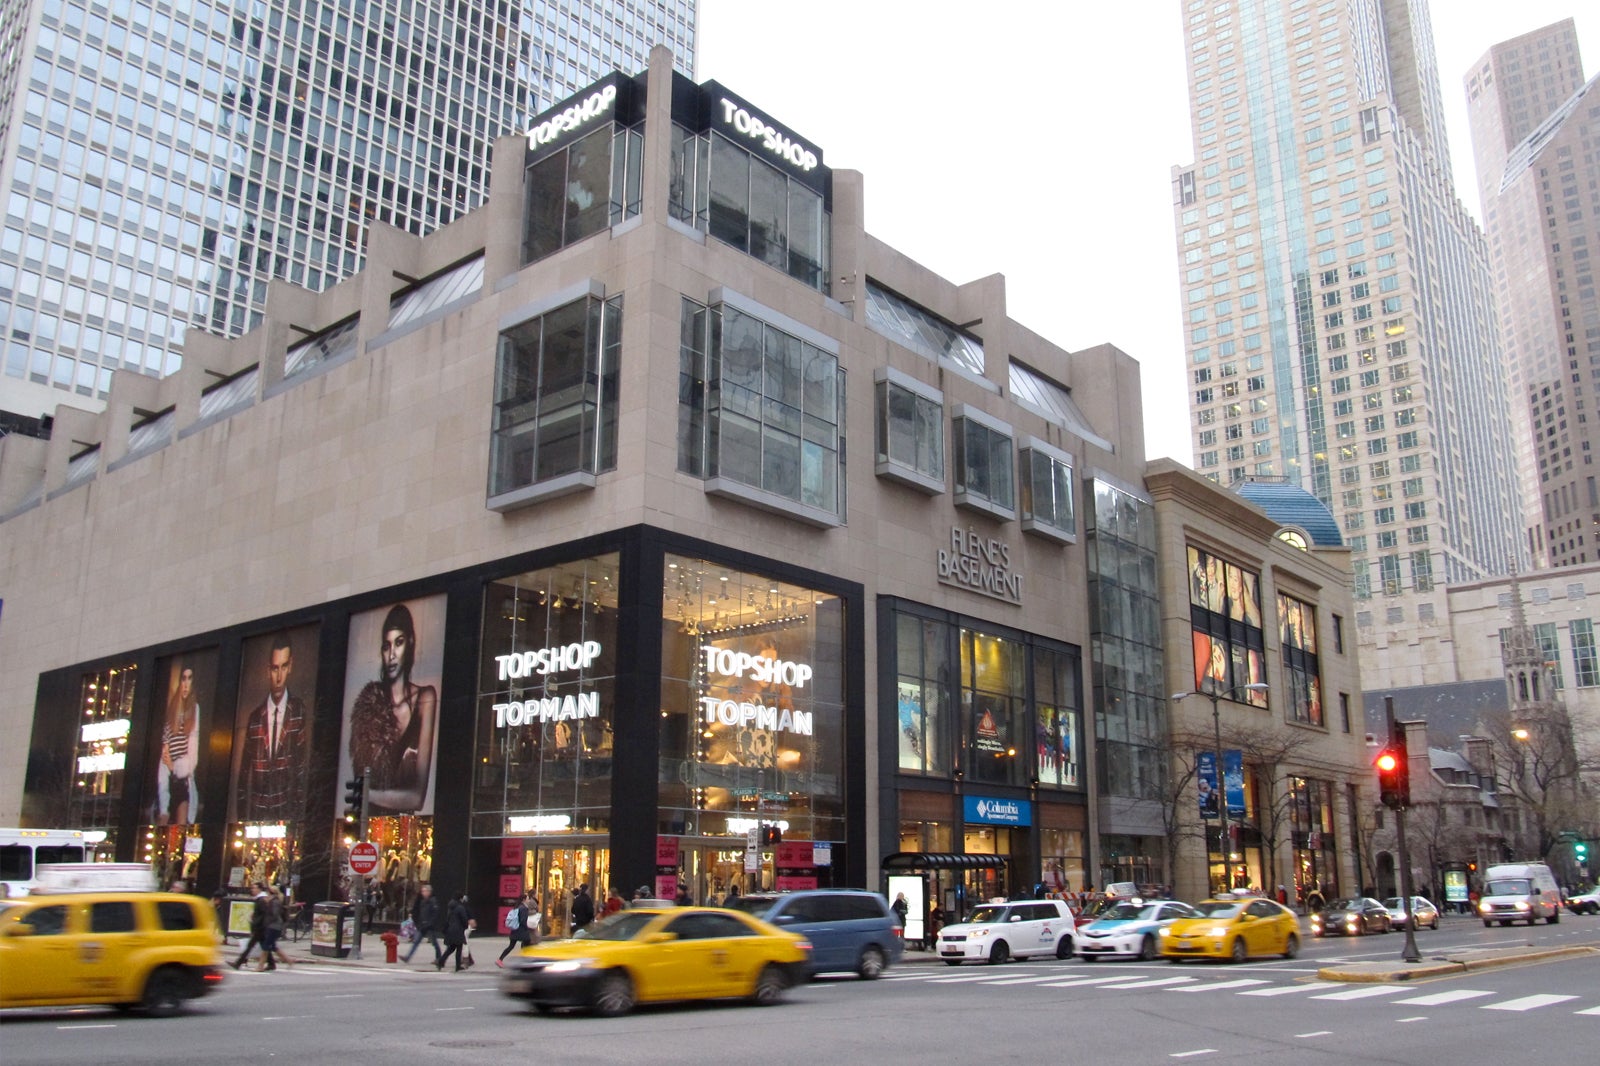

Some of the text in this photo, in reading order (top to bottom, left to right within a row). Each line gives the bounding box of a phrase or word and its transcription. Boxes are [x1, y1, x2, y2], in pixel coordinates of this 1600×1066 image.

[526, 84, 617, 151] TOPSHOP
[721, 97, 818, 171] TOPSHOP
[951, 526, 1011, 570] FILENE'S
[938, 548, 1024, 601] BASEMENT
[495, 640, 602, 681] TOPSHOP
[703, 645, 813, 688] TOPSHOP
[492, 691, 600, 728] TOPMAN
[702, 696, 813, 736] TOPMAN
[986, 800, 1019, 815] Columbia
